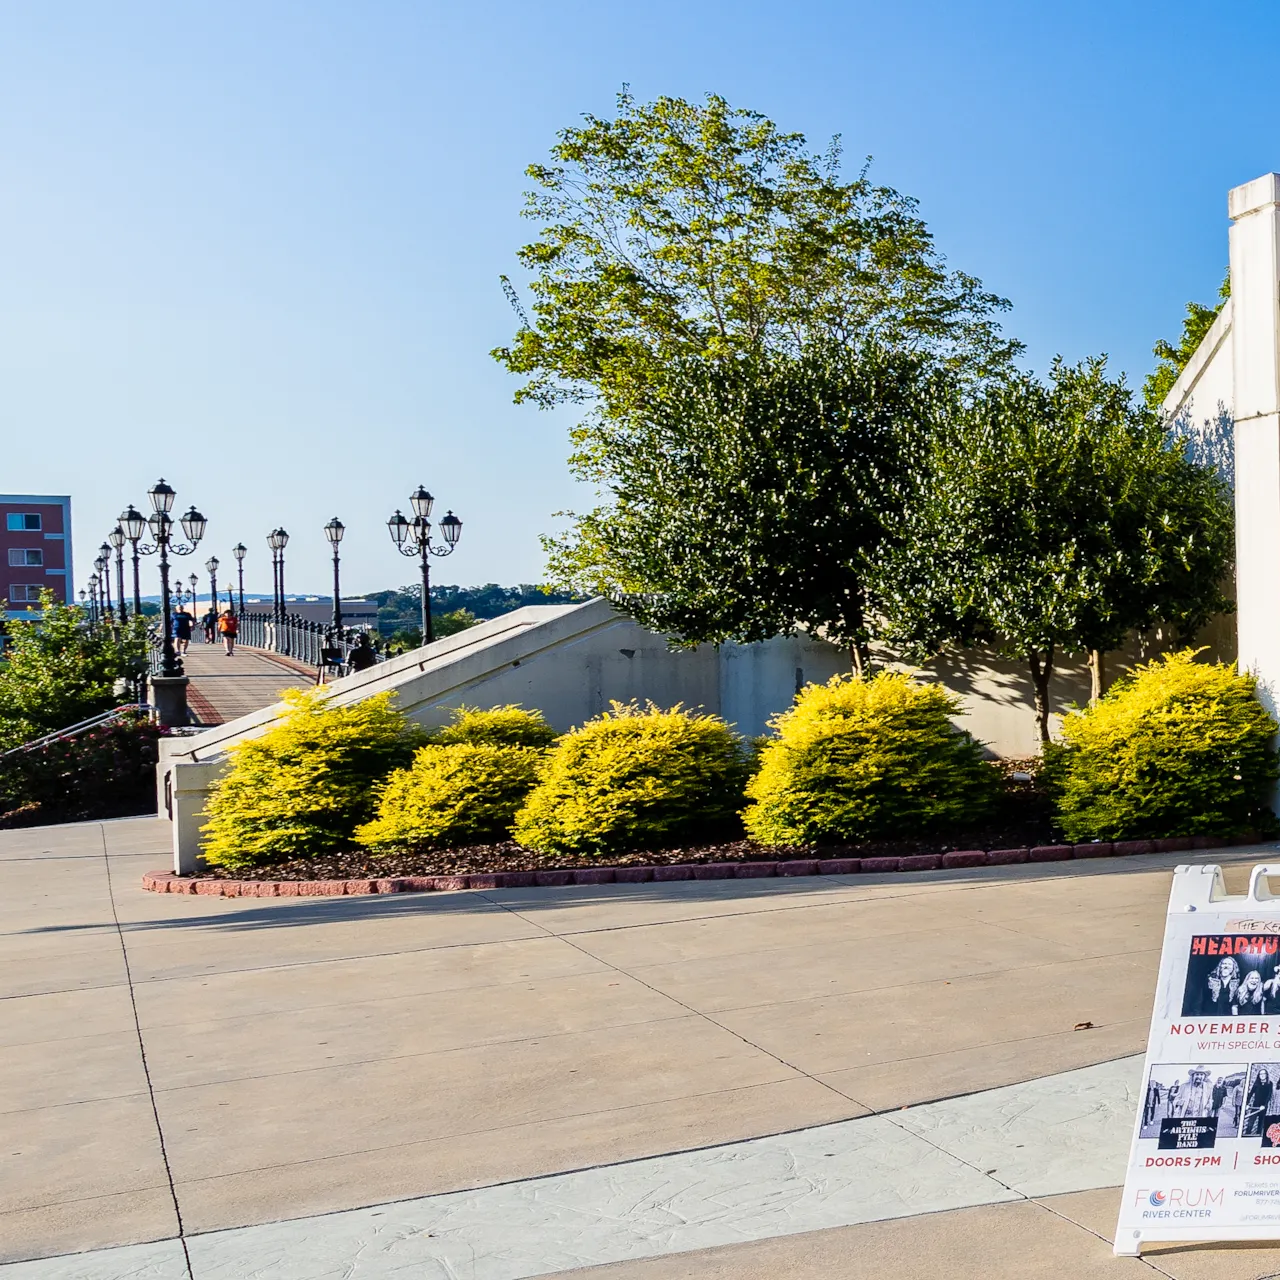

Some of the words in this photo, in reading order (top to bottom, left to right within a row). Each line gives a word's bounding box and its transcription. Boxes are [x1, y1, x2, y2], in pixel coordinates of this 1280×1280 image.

[1234, 919, 1260, 931] THE
[1170, 1023, 1269, 1035] NOVEMBER
[1197, 1041, 1225, 1050] WITH
[1228, 1040, 1270, 1049] SPECIAL
[1170, 1126, 1207, 1134] ARTIMUS
[1177, 1133, 1197, 1141] PYLE
[1176, 1140, 1198, 1148] BAND
[1145, 1157, 1191, 1167] DOORS
[1194, 1156, 1221, 1168] 7PM
[1245, 1181, 1268, 1189] Tickets
[1134, 1188, 1224, 1207] FORUM
[1142, 1210, 1170, 1219] RIVER
[1173, 1209, 1211, 1218] CENTER
